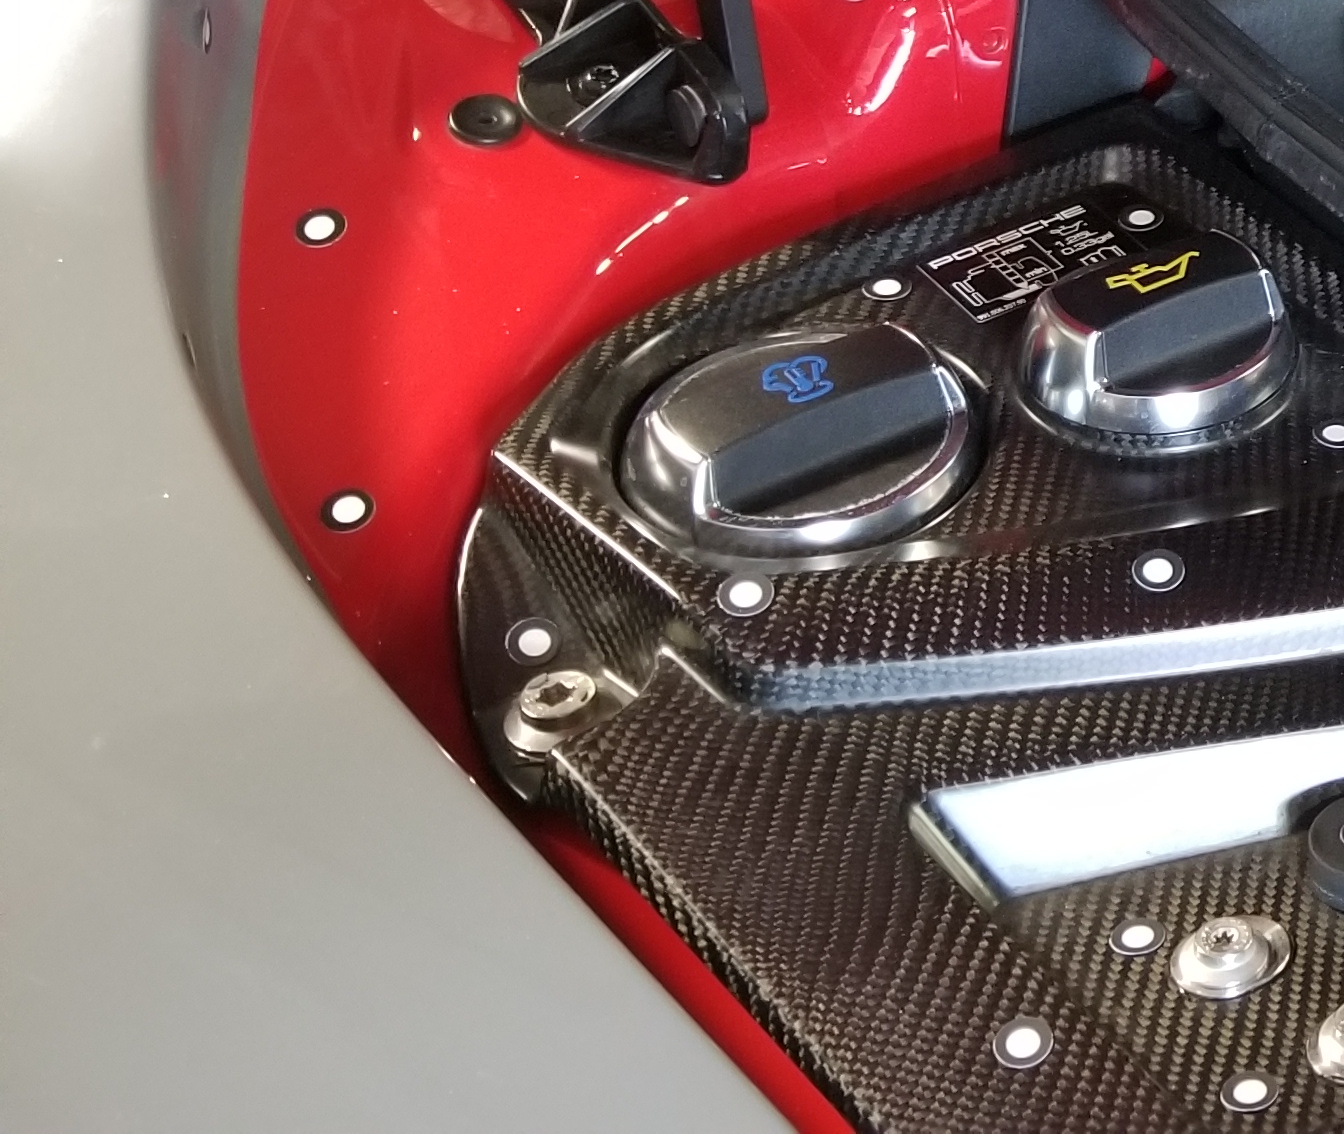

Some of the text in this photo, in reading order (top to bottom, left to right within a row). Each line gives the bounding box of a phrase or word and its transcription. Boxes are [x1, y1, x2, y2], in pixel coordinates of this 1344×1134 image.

[927, 204, 1087, 270] PORSCHE
[999, 243, 1028, 257] max
[1024, 266, 1048, 278] min
